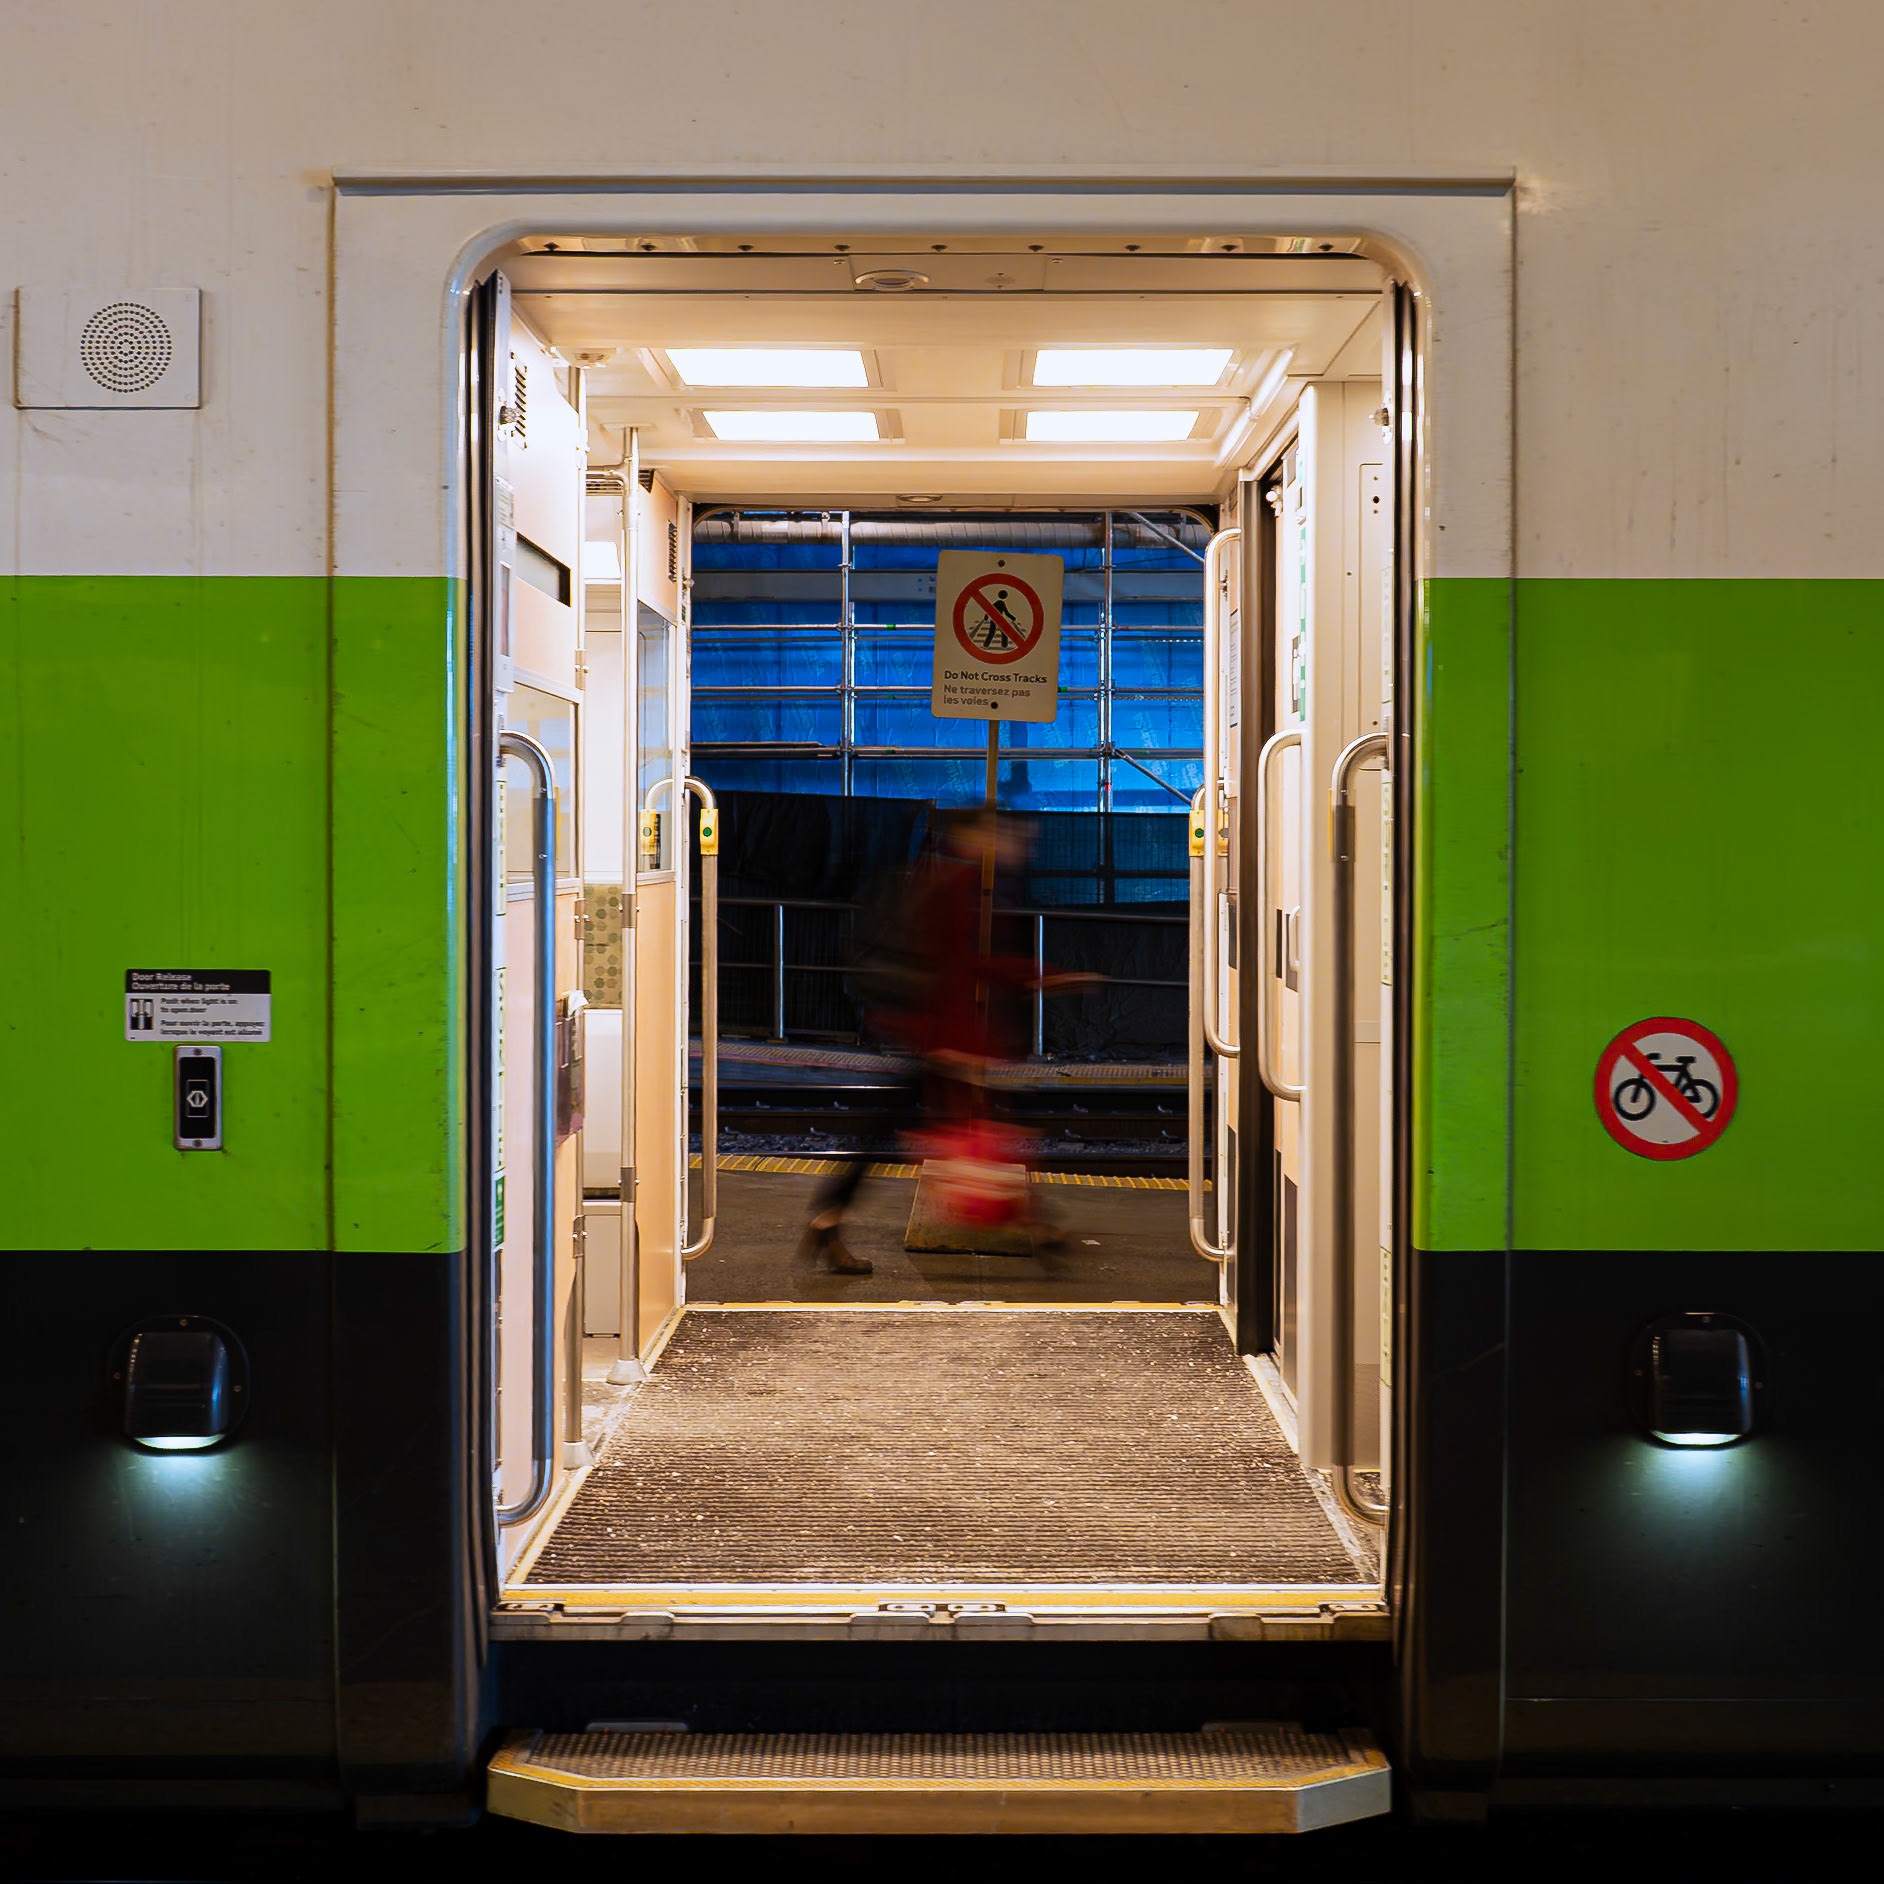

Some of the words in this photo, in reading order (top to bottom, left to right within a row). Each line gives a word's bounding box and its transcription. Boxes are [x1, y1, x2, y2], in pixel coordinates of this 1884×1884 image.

[944, 670, 959, 680] Do
[961, 671, 979, 681] Not
[981, 672, 1011, 682] Cross
[1013, 673, 1048, 684] Tracks
[944, 684, 958, 694] Ne
[960, 686, 1010, 696] traversez
[1012, 688, 1031, 698] pas
[943, 695, 959, 705] les
[960, 696, 989, 706] voies
[132, 972, 154, 981] Door
[155, 972, 192, 981] Release
[131, 982, 179, 990] Ouverture
[180, 981, 193, 990] de
[193, 981, 203, 990] la
[204, 982, 231, 992] porte
